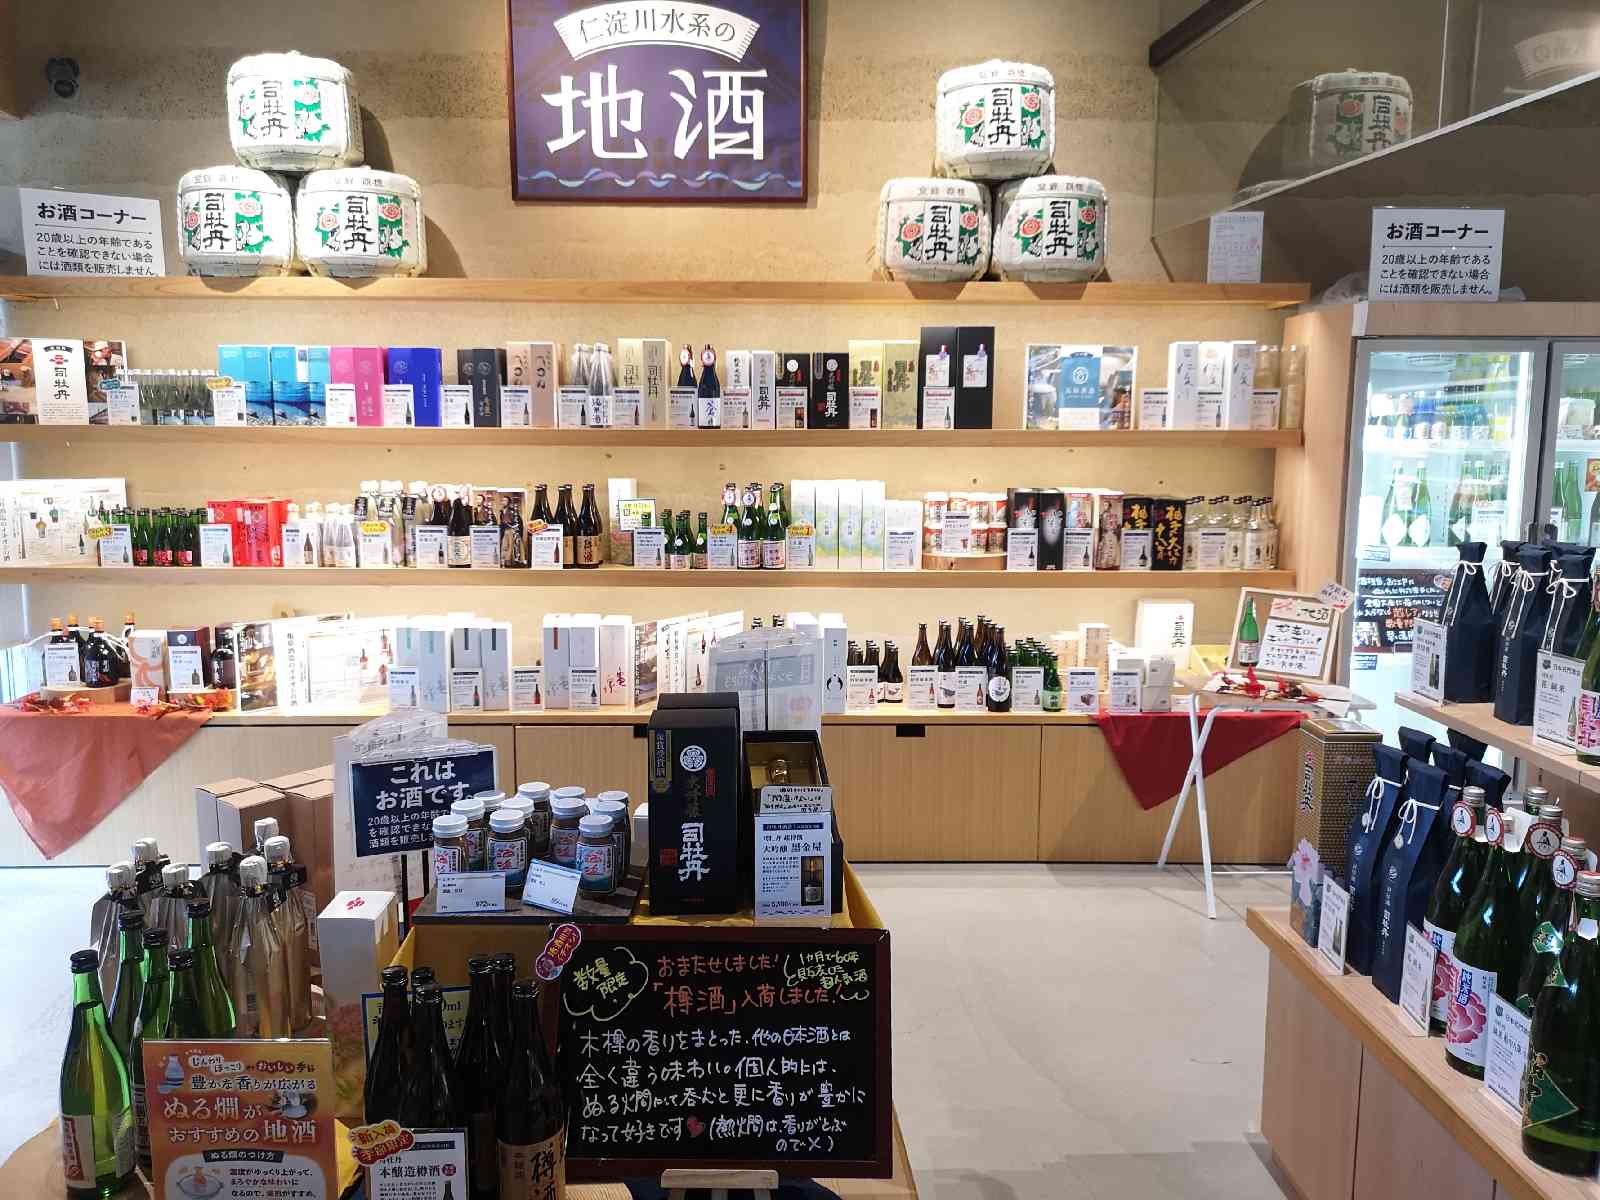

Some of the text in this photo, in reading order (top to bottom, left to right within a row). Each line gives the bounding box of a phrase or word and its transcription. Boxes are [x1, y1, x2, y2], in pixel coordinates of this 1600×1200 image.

[579, 8, 736, 43] 仁淀川水系の
[260, 80, 289, 139] 司牡丹
[541, 64, 768, 160] 地酒
[988, 88, 1018, 145] 司牡丹
[37, 203, 147, 224] お酒コーナー
[202, 192, 231, 250] 司牡丹
[343, 195, 375, 252] 司牡丹
[36, 232, 153, 249] 20歳以上の年齢である
[924, 205, 953, 262] 司牡丹
[1045, 200, 1074, 257] 司牡丹
[1387, 222, 1489, 240] お酒コーナー
[38, 246, 153, 263] ことを確認できない場合
[1381, 254, 1491, 265] 20歳以上の年齢である
[1380, 269, 1489, 280] ことを確認できない場合
[1379, 283, 1493, 295] には酒類を販売しません。
[824, 391, 839, 418] 司牡丹
[390, 760, 457, 784] これは
[375, 781, 476, 811] お酒です。
[677, 822, 711, 882] 司牡丹
[572, 956, 611, 991] 数量
[595, 971, 630, 999] 限定
[191, 1075, 317, 1091] 豊かな香りが広がる
[164, 1097, 263, 1121] ぬる燗が
[168, 1119, 318, 1144] おすすめの地酒
[210, 1151, 275, 1161] ぬる燗のつけ方
[379, 1165, 441, 1179] 本醸造樽酒
